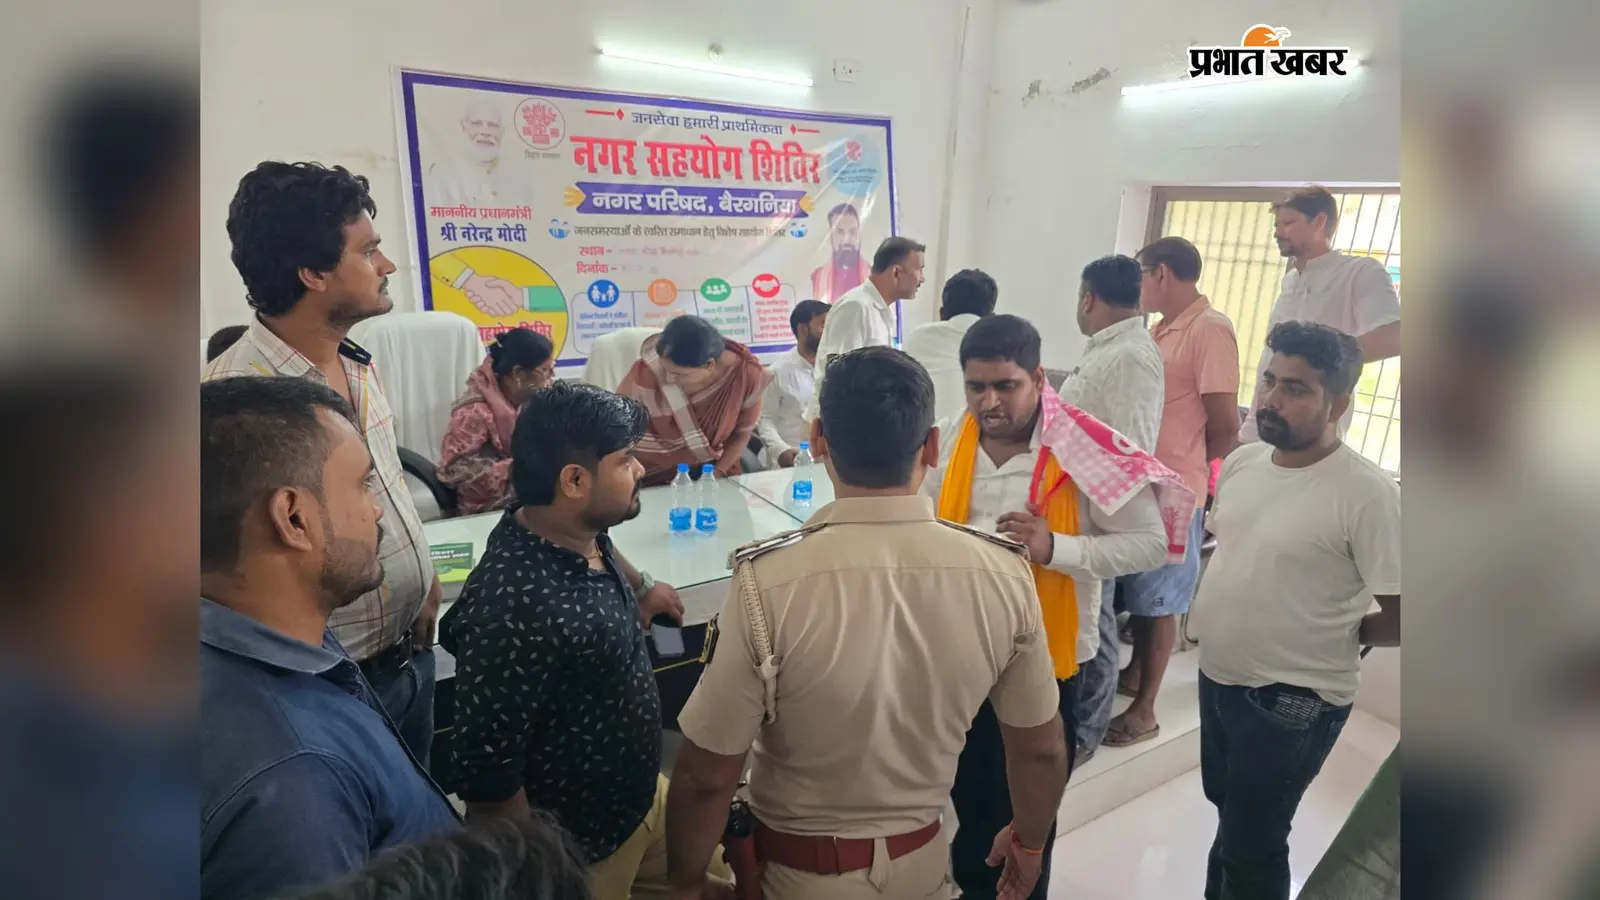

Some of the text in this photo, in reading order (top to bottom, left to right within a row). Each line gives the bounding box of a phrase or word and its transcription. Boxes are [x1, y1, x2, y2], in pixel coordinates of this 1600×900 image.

[631, 110, 783, 135] जनसेवा हमारी प्राथमिकता
[570, 133, 821, 184] नगर सहयोग शिविर
[592, 191, 643, 211] नगर
[646, 188, 714, 214] परिषद,
[430, 204, 532, 220] माननीय प्रधानमंत्री
[440, 222, 527, 242] श्री नरेन्द्र मोदी
[579, 246, 604, 256] स्थान
[576, 260, 608, 274] दिनांक
